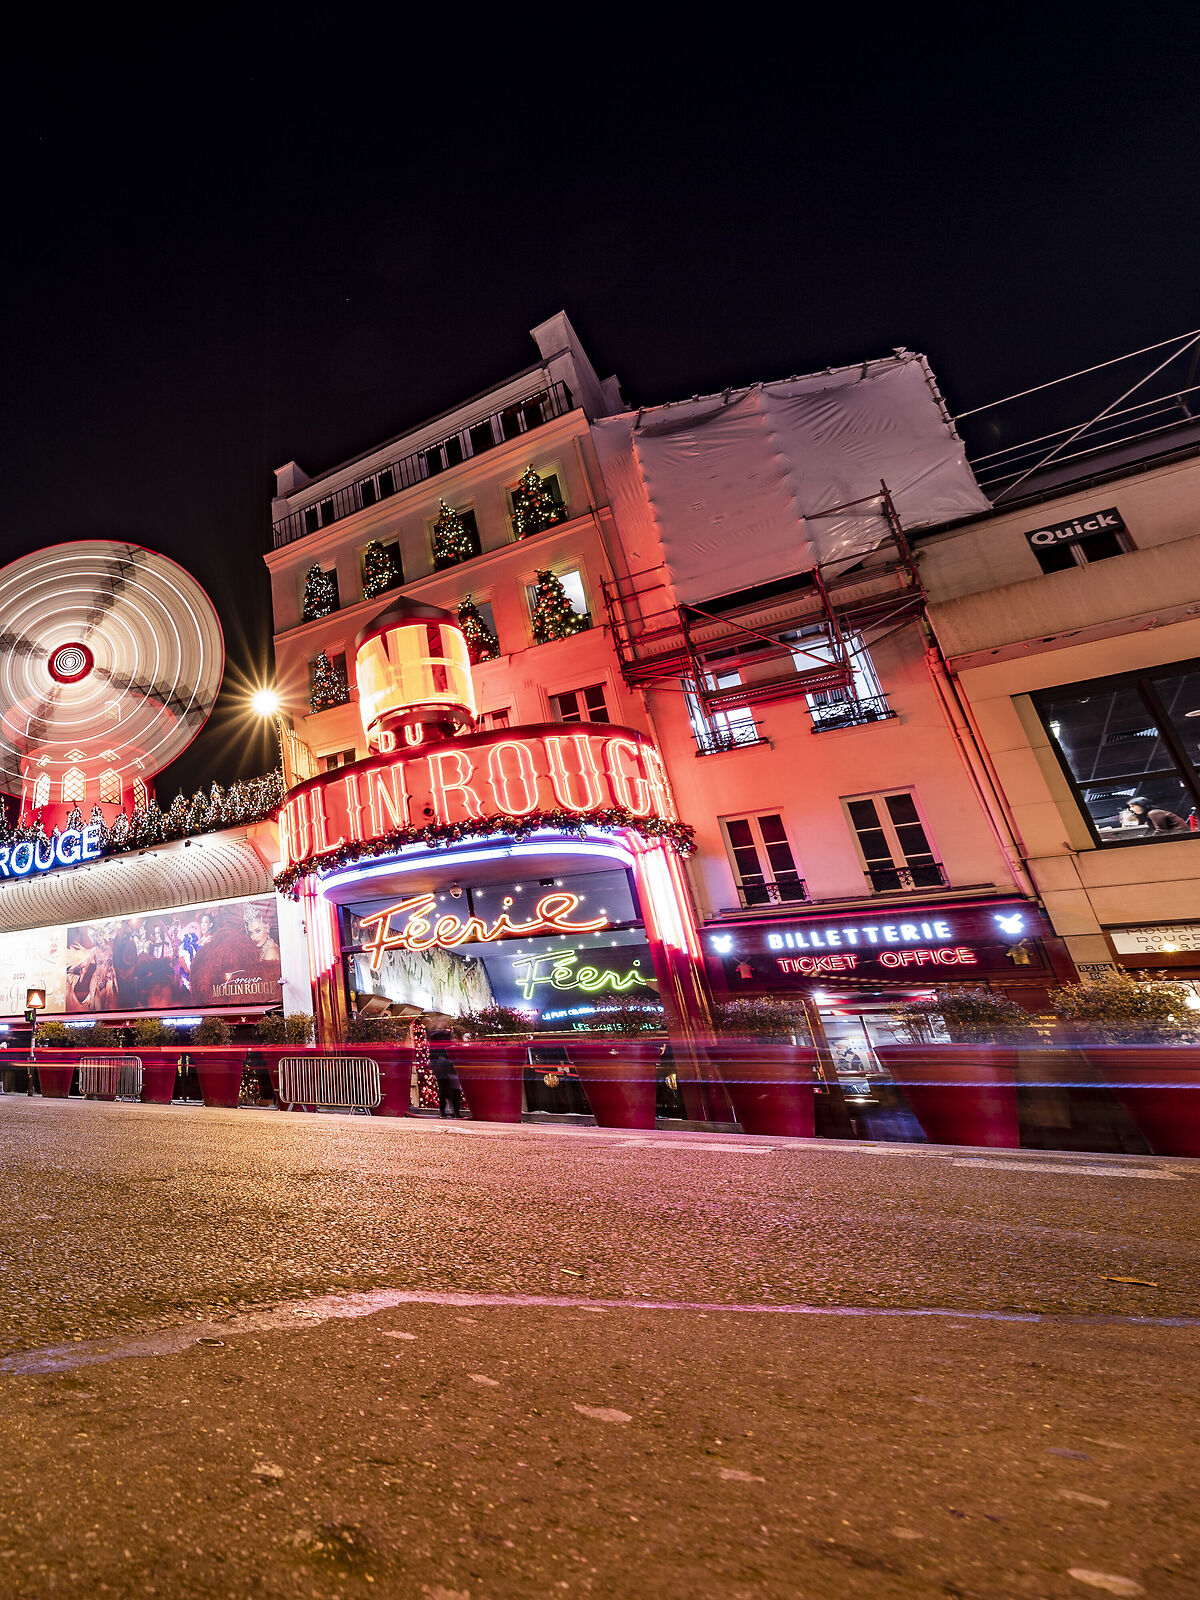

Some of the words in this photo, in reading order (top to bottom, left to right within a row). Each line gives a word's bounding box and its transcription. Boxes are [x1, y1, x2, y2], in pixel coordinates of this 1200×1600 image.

[1031, 513, 1119, 545] Quick
[377, 722, 423, 753] DU
[359, 892, 608, 971] Féerie
[768, 921, 952, 950] BILLETTERIE
[512, 949, 658, 1000] Féeri
[777, 954, 858, 973] TICKET
[880, 947, 978, 968] OFFICE
[212, 983, 243, 998] MOULIN
[244, 981, 274, 995] ROUGE
[219, 969, 263, 987] Forever
